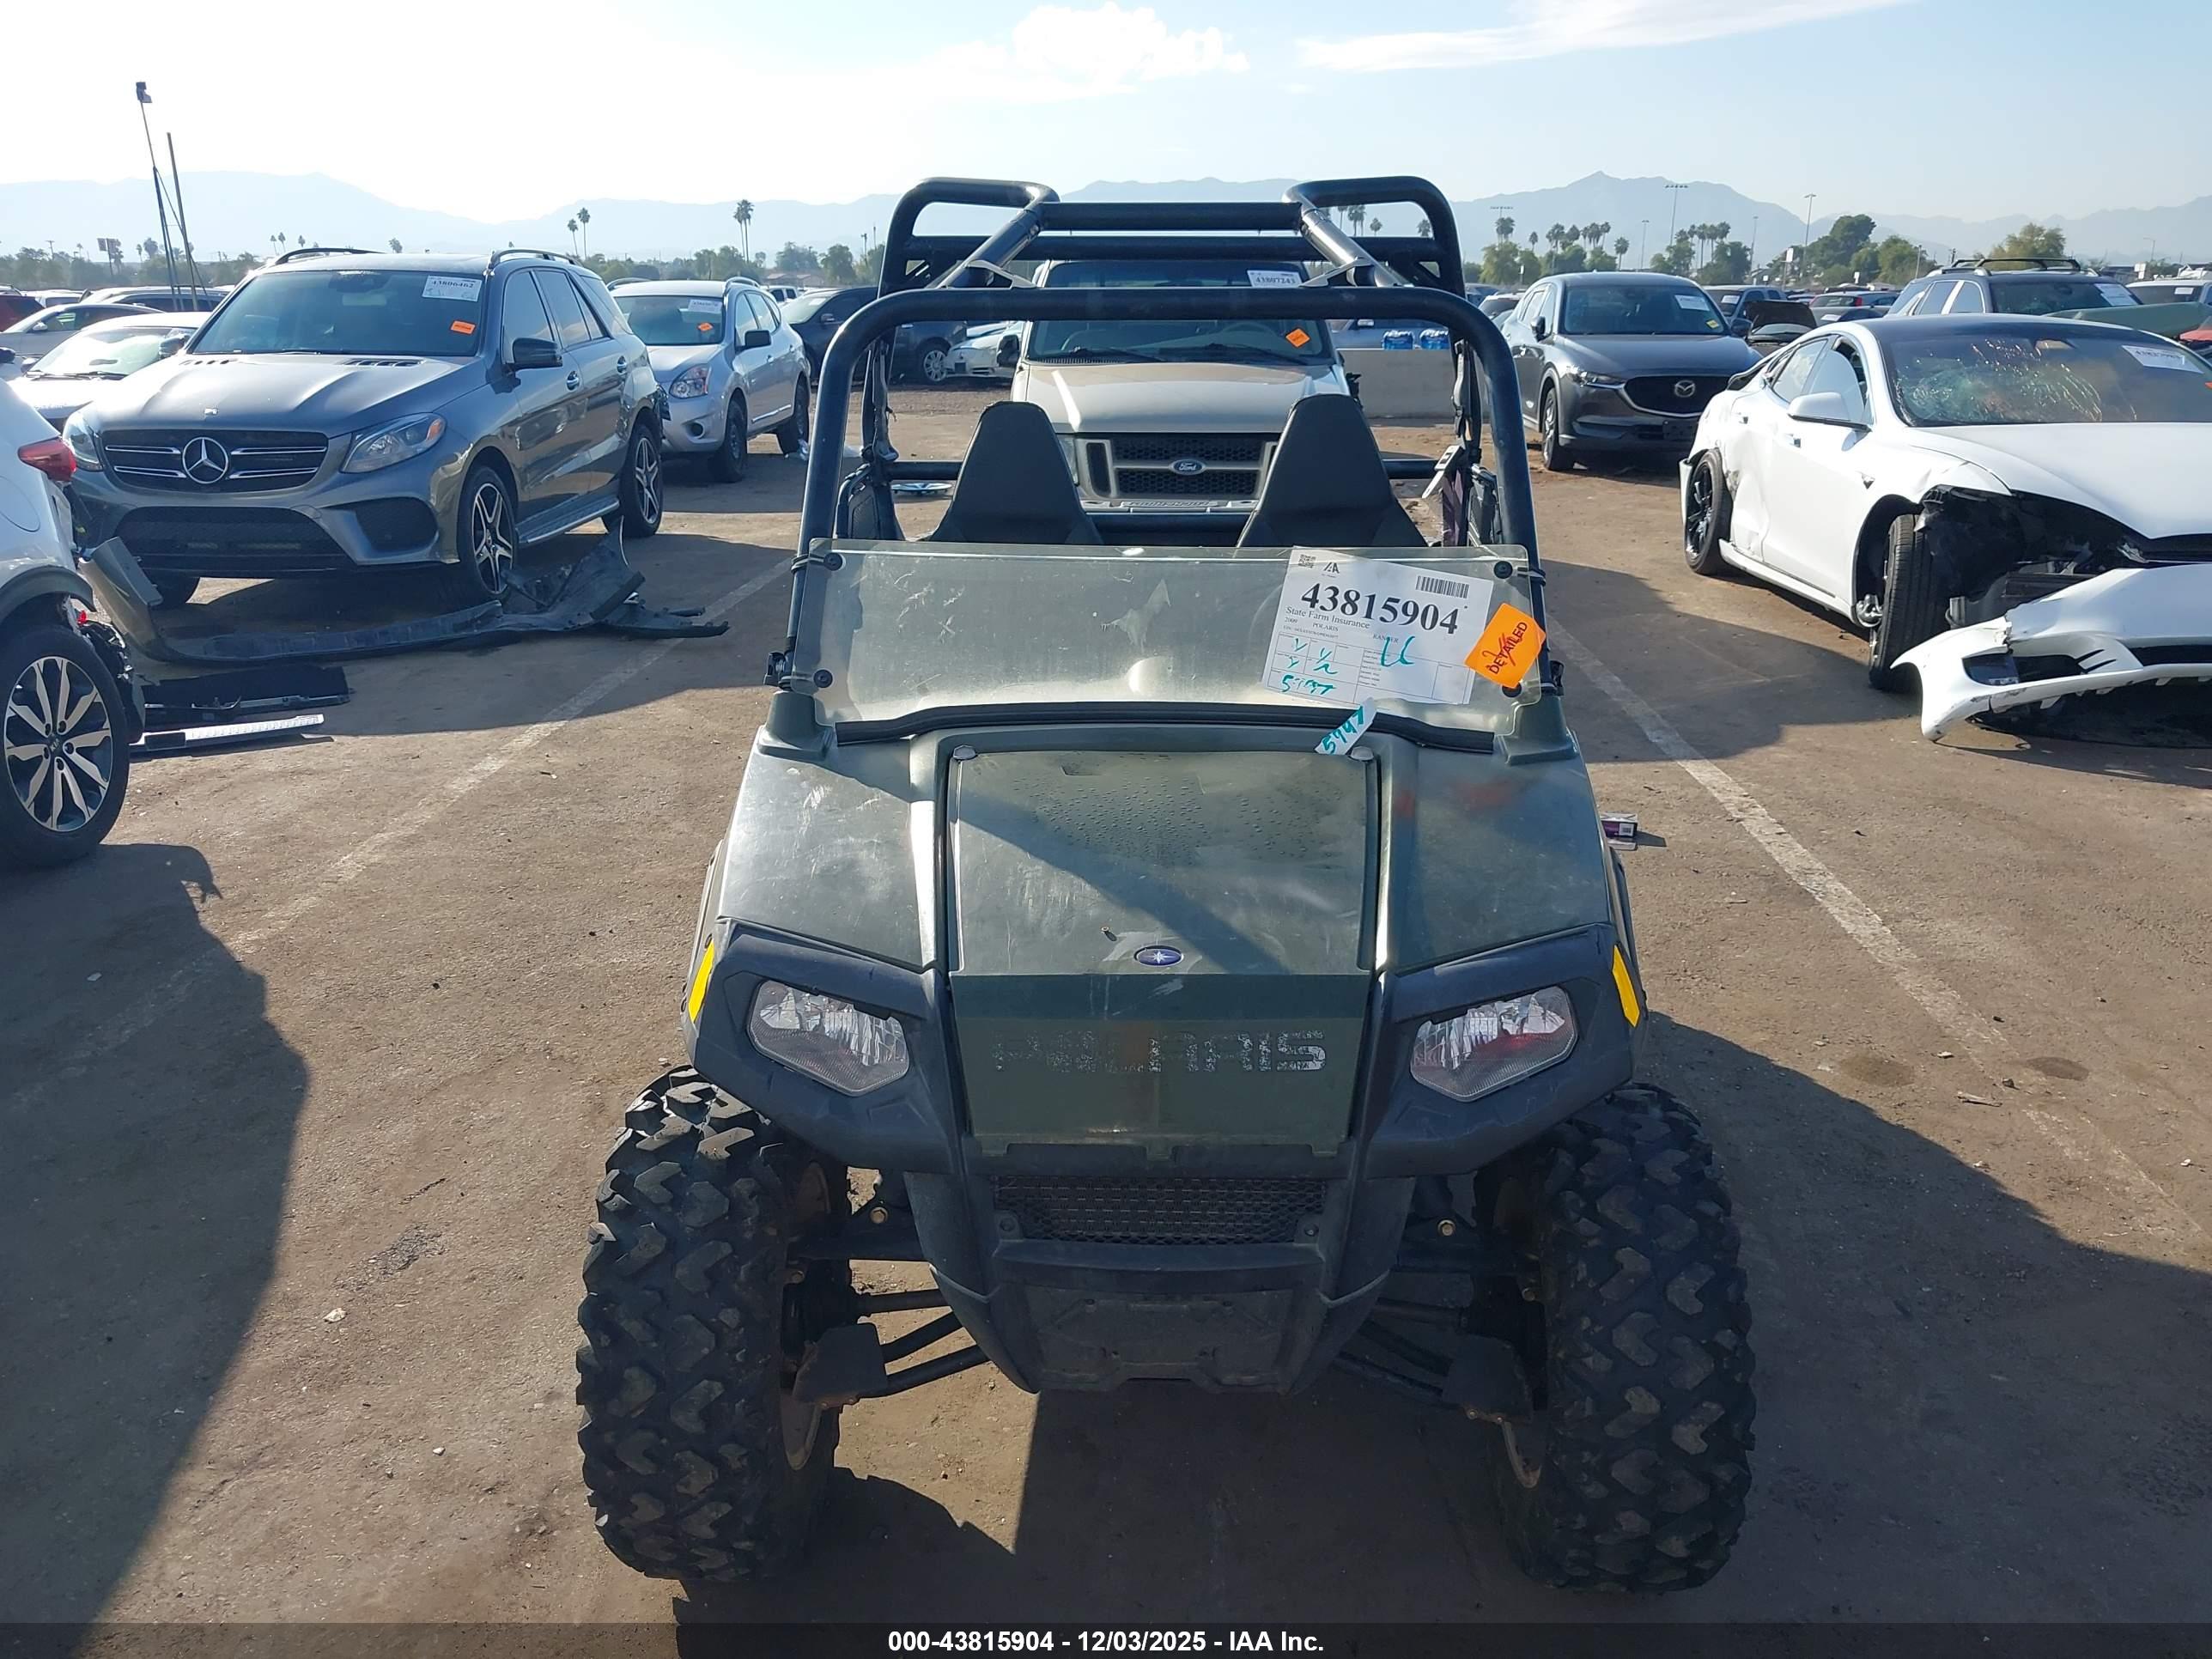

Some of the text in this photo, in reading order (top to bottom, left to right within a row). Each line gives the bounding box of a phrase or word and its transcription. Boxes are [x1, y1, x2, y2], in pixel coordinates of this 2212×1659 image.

[1285, 606, 1371, 629] State Farm Insurance
[1301, 582, 1459, 635] 43815904
[1312, 622, 1340, 632] POLARIS
[1373, 632, 1400, 644] RANER
[1488, 621, 1528, 675] DETAILED
